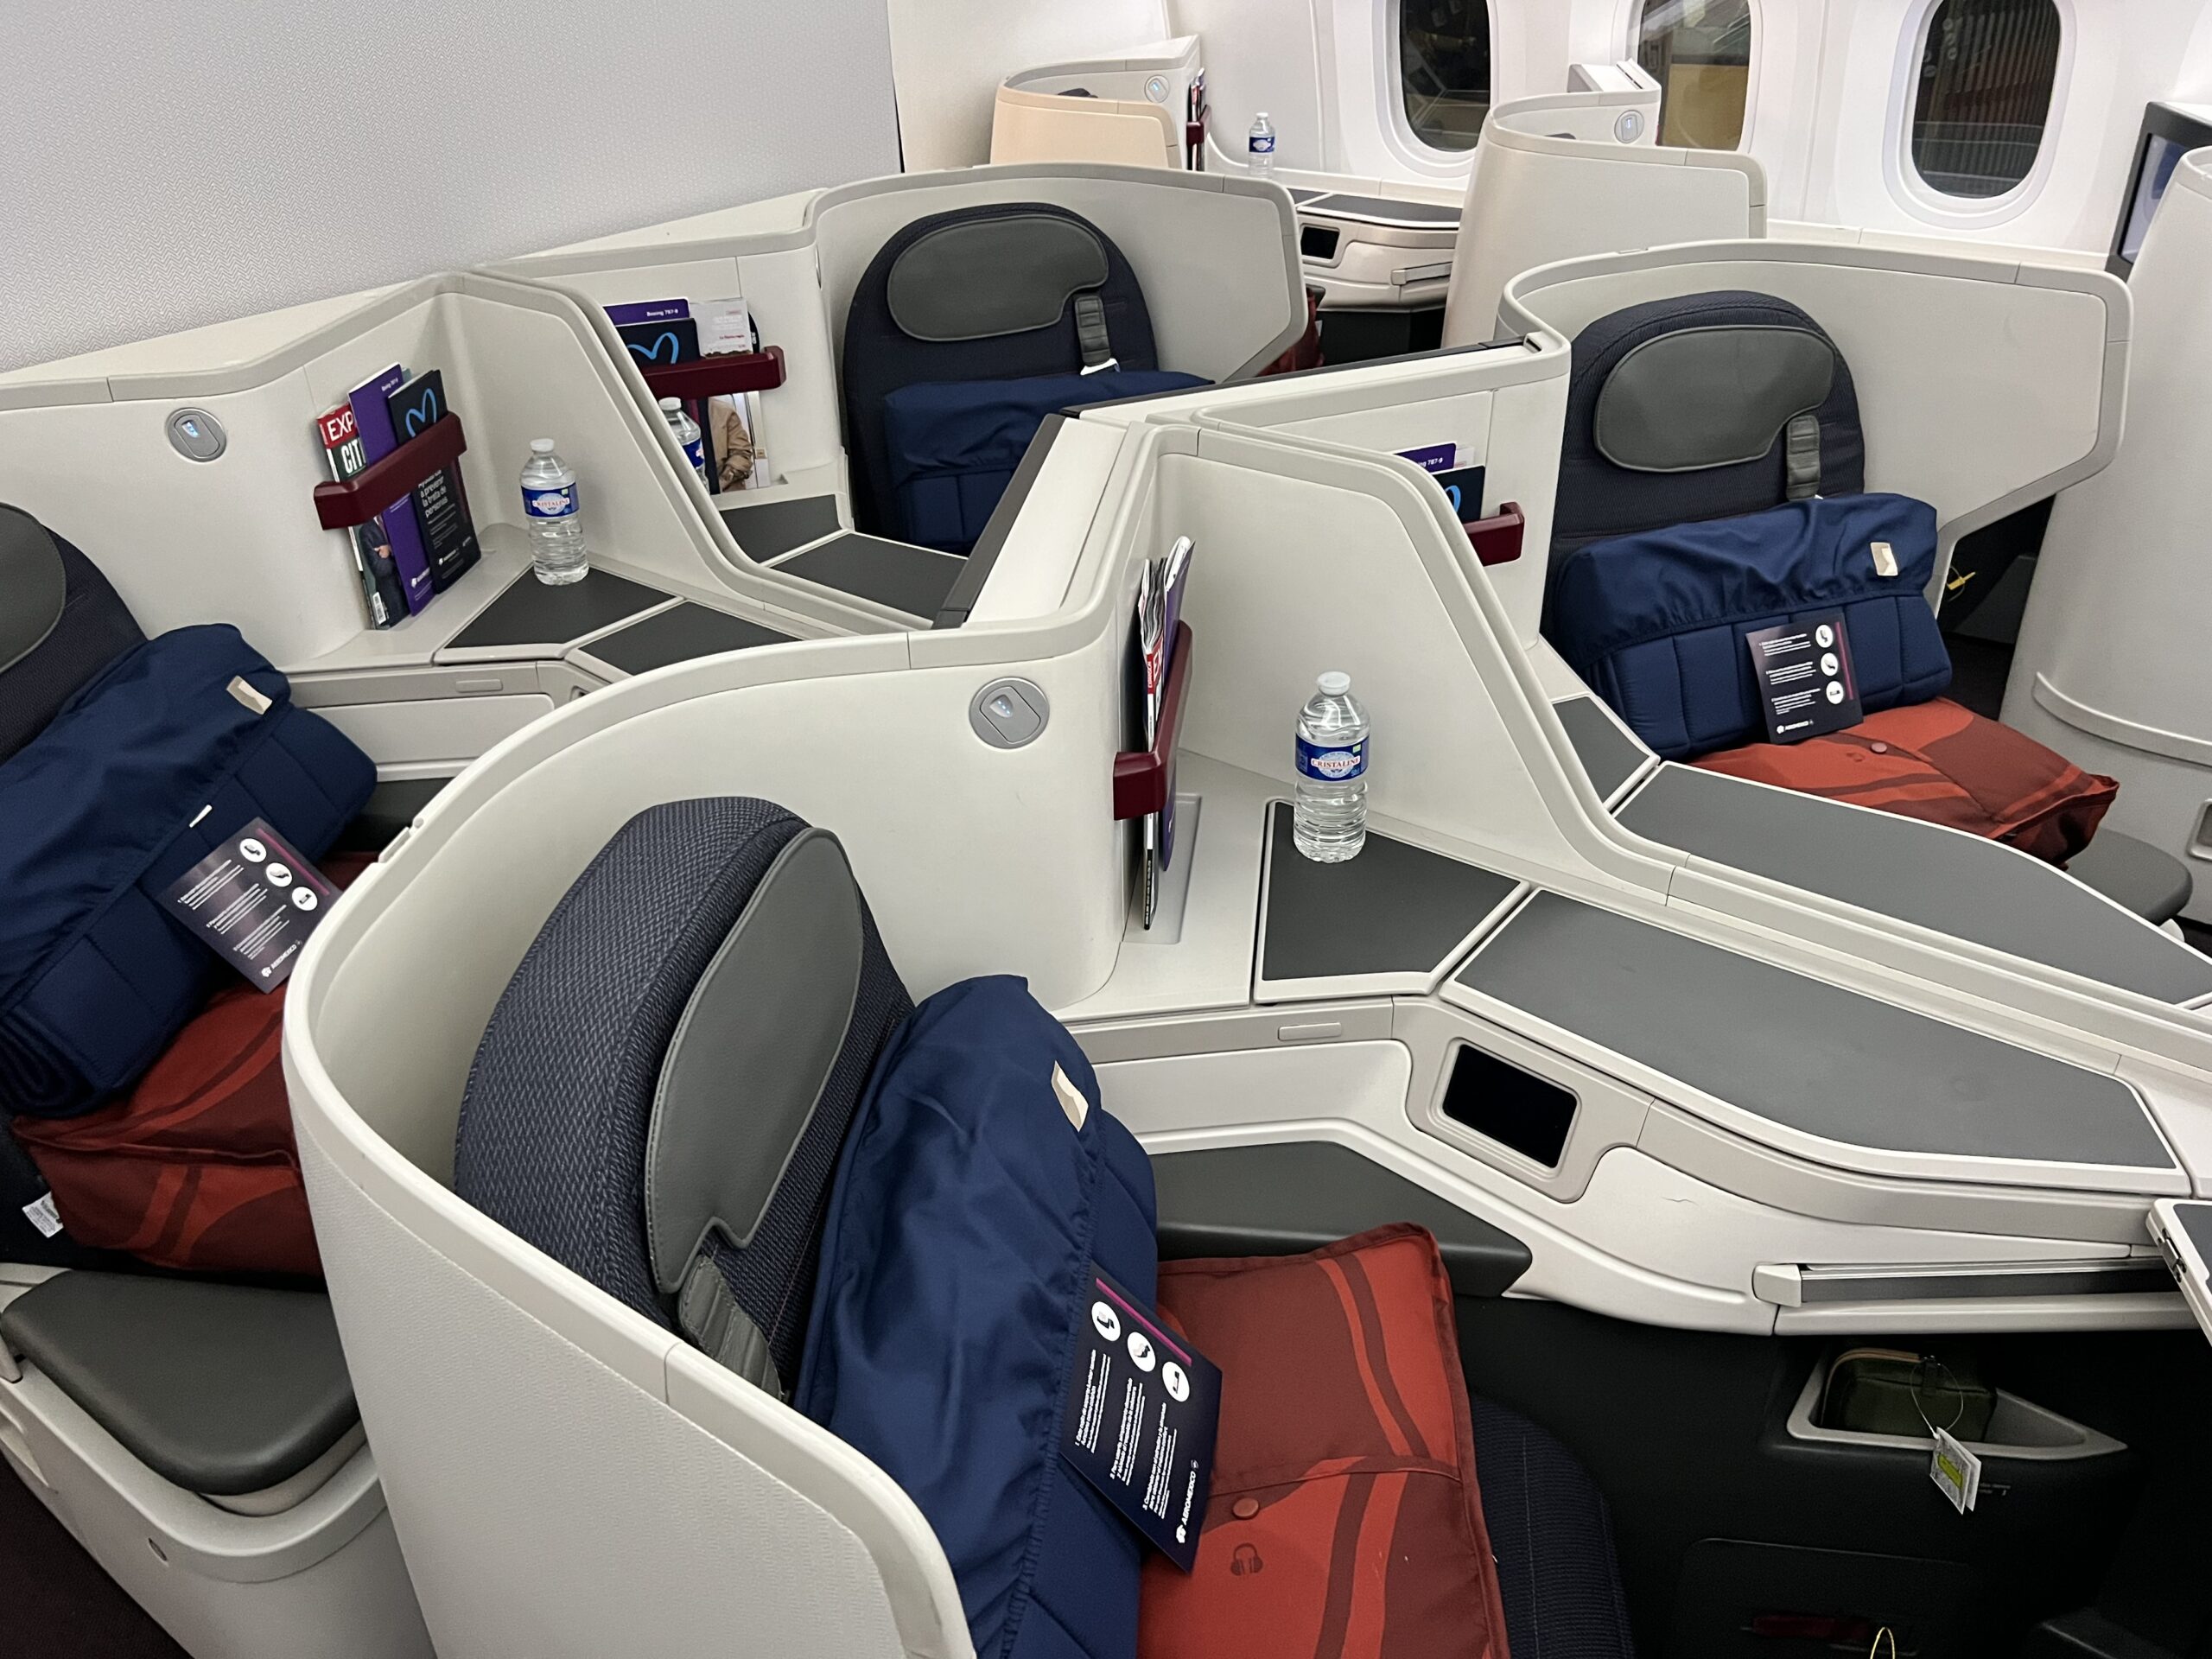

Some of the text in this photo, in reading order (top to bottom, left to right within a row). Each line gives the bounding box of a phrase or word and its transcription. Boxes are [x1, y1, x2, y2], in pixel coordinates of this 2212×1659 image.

[327, 411, 354, 442] EXP
[1312, 758, 1359, 768] CRISTALINE
[1181, 1470, 1197, 1527] AEROMEXICO
